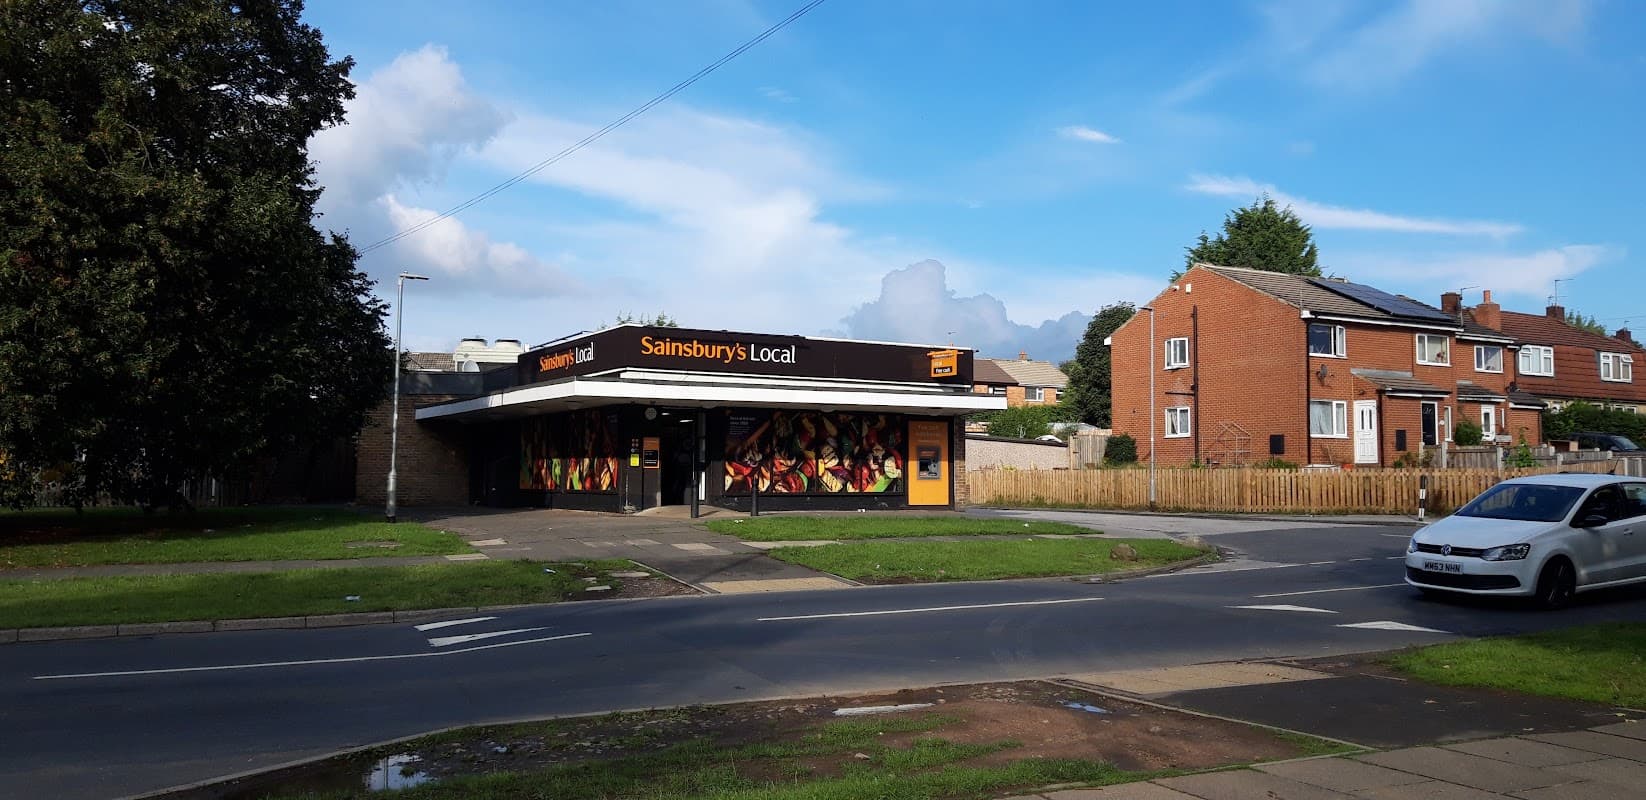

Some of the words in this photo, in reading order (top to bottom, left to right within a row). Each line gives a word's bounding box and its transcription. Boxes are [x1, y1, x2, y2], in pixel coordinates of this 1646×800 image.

[540, 349, 575, 372] Sainsbury's
[575, 342, 594, 364] Local
[641, 336, 747, 363] Sainsbury's
[750, 343, 796, 364] Local
